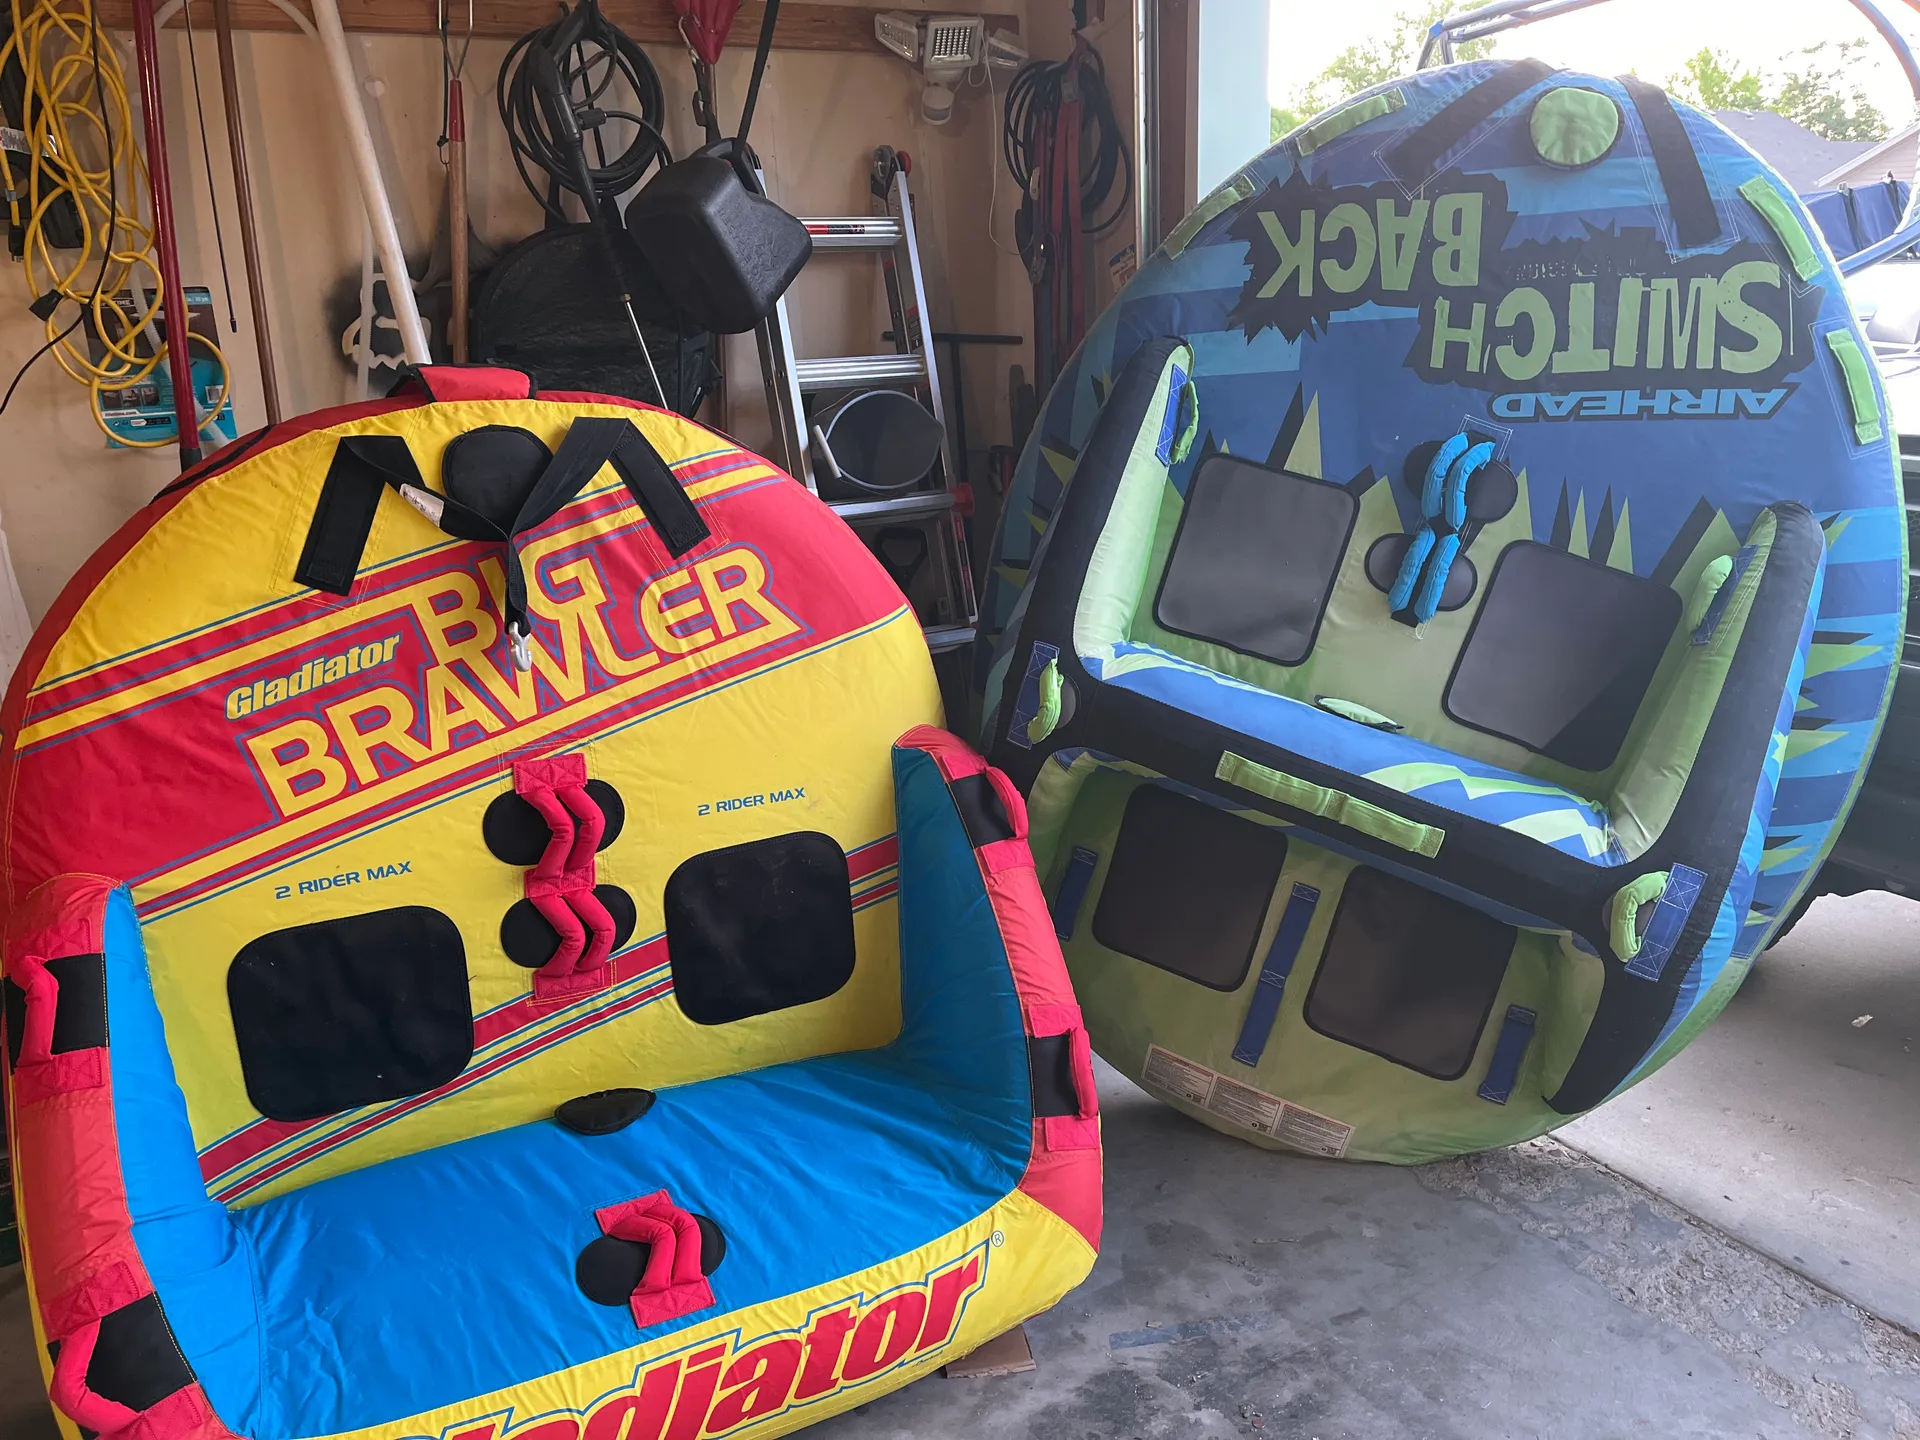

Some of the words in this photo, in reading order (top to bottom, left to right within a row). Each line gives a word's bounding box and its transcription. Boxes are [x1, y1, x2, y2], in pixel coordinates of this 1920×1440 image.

[1257, 192, 1484, 298] BACK
[1430, 261, 1782, 380] SWITCH
[1492, 389, 1787, 418] AIRHEAD
[226, 634, 400, 720] Gladiator
[247, 549, 802, 817] BRAWLER
[698, 804, 710, 816] 2
[716, 795, 764, 812] RIDER
[769, 787, 805, 803] MAX
[275, 885, 291, 900] 2
[298, 872, 360, 894] RIDER
[367, 861, 412, 880] MAX
[448, 1256, 979, 1440] diator
